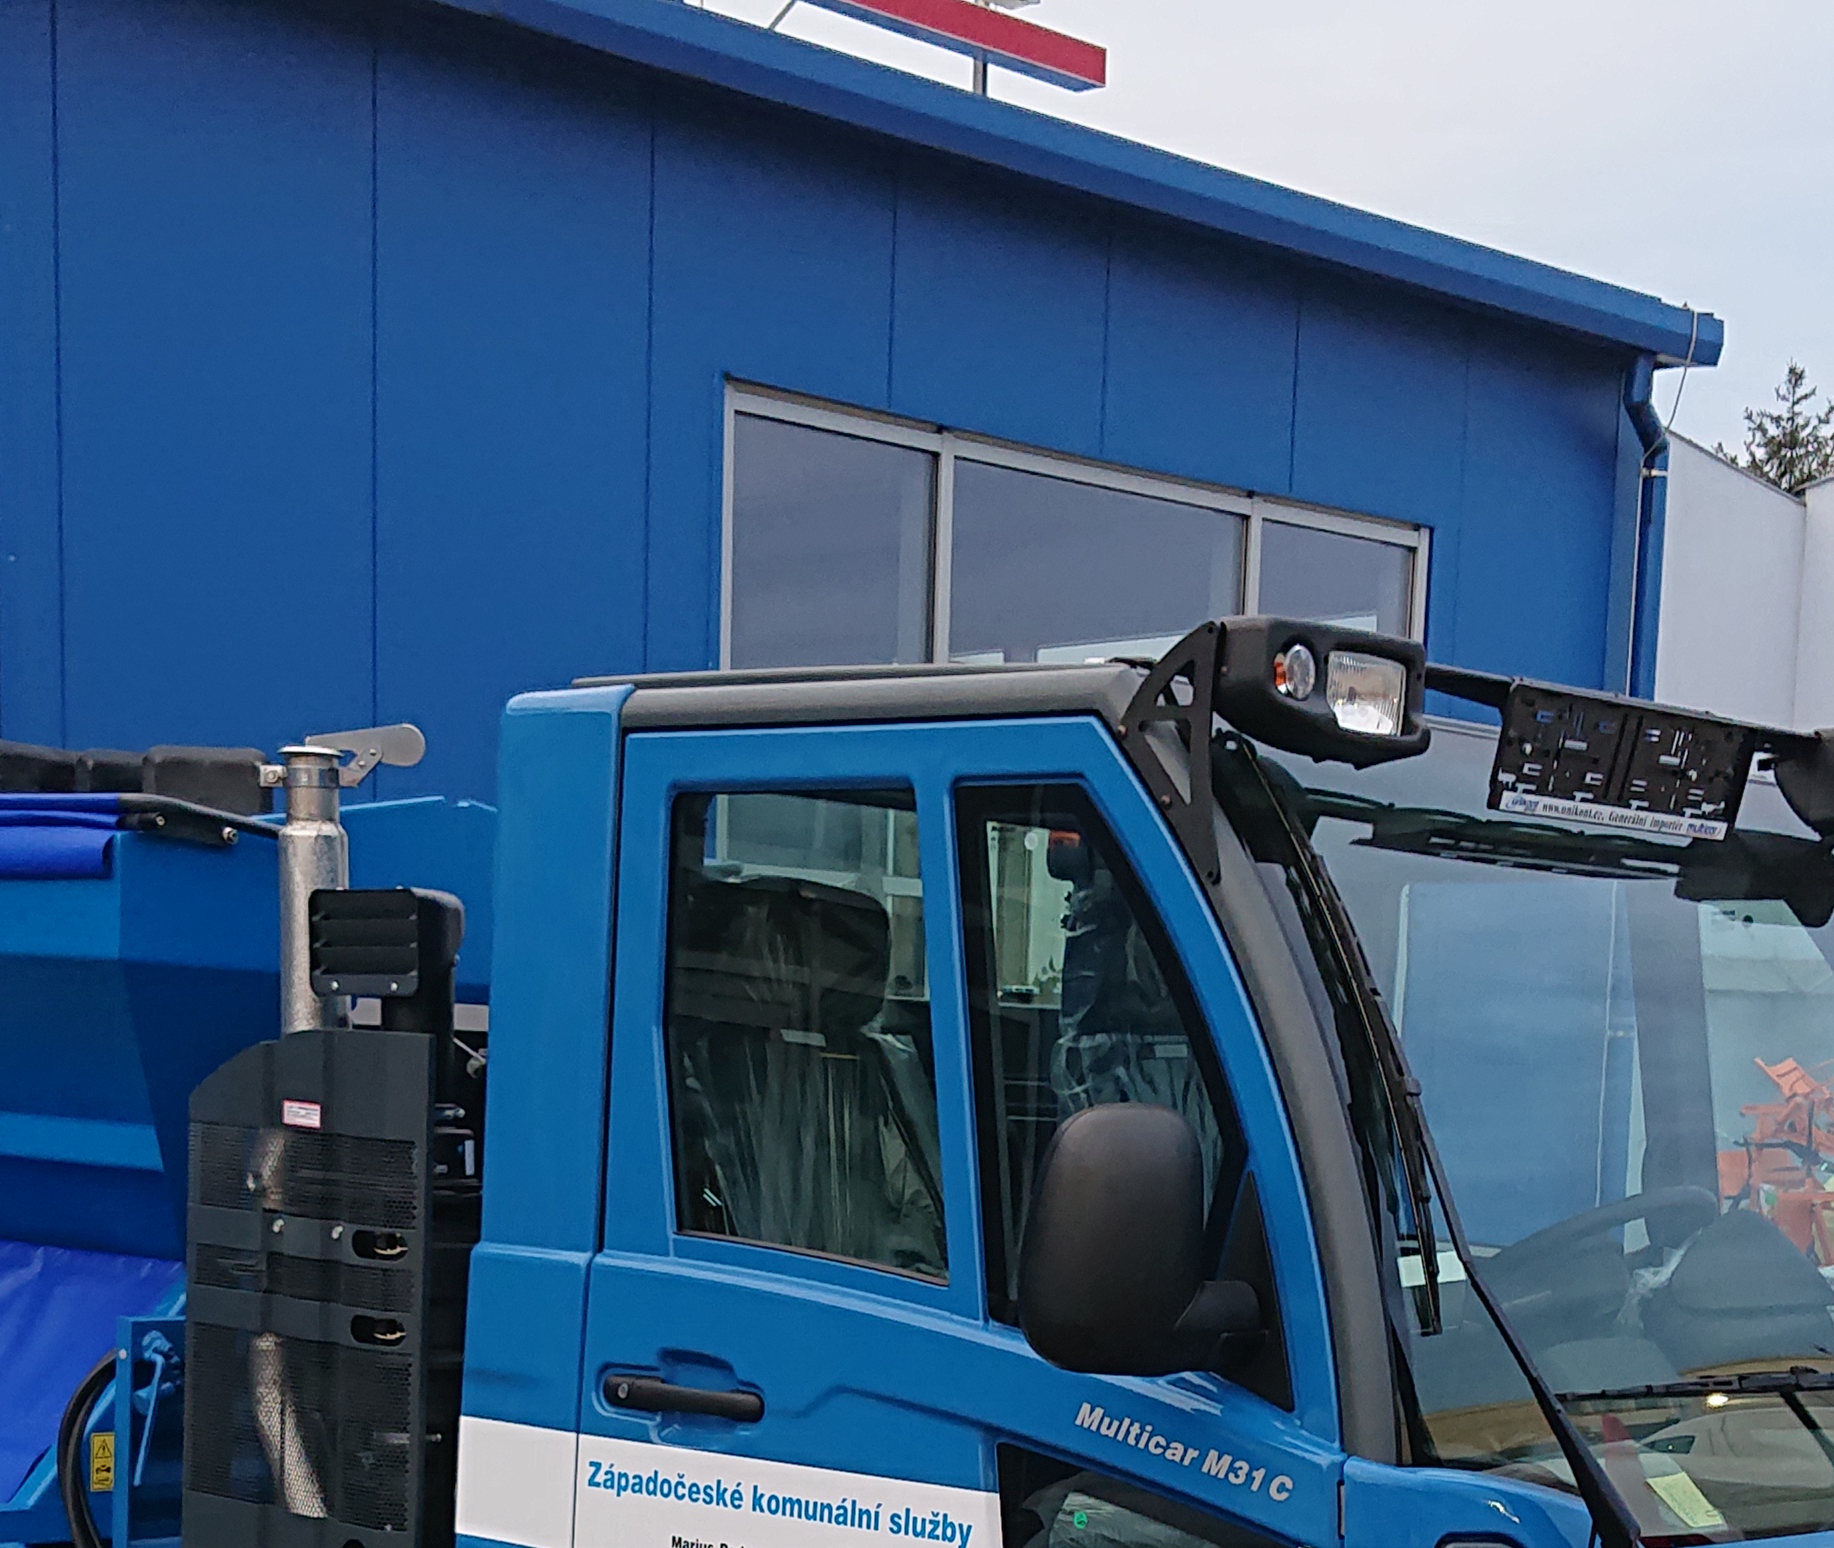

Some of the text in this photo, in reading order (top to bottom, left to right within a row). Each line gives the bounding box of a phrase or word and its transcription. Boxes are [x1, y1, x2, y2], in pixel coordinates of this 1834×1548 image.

[1074, 1401, 1200, 1467] Multicar
[586, 1460, 743, 1511] Západočeské
[751, 1485, 883, 1532] komunální
